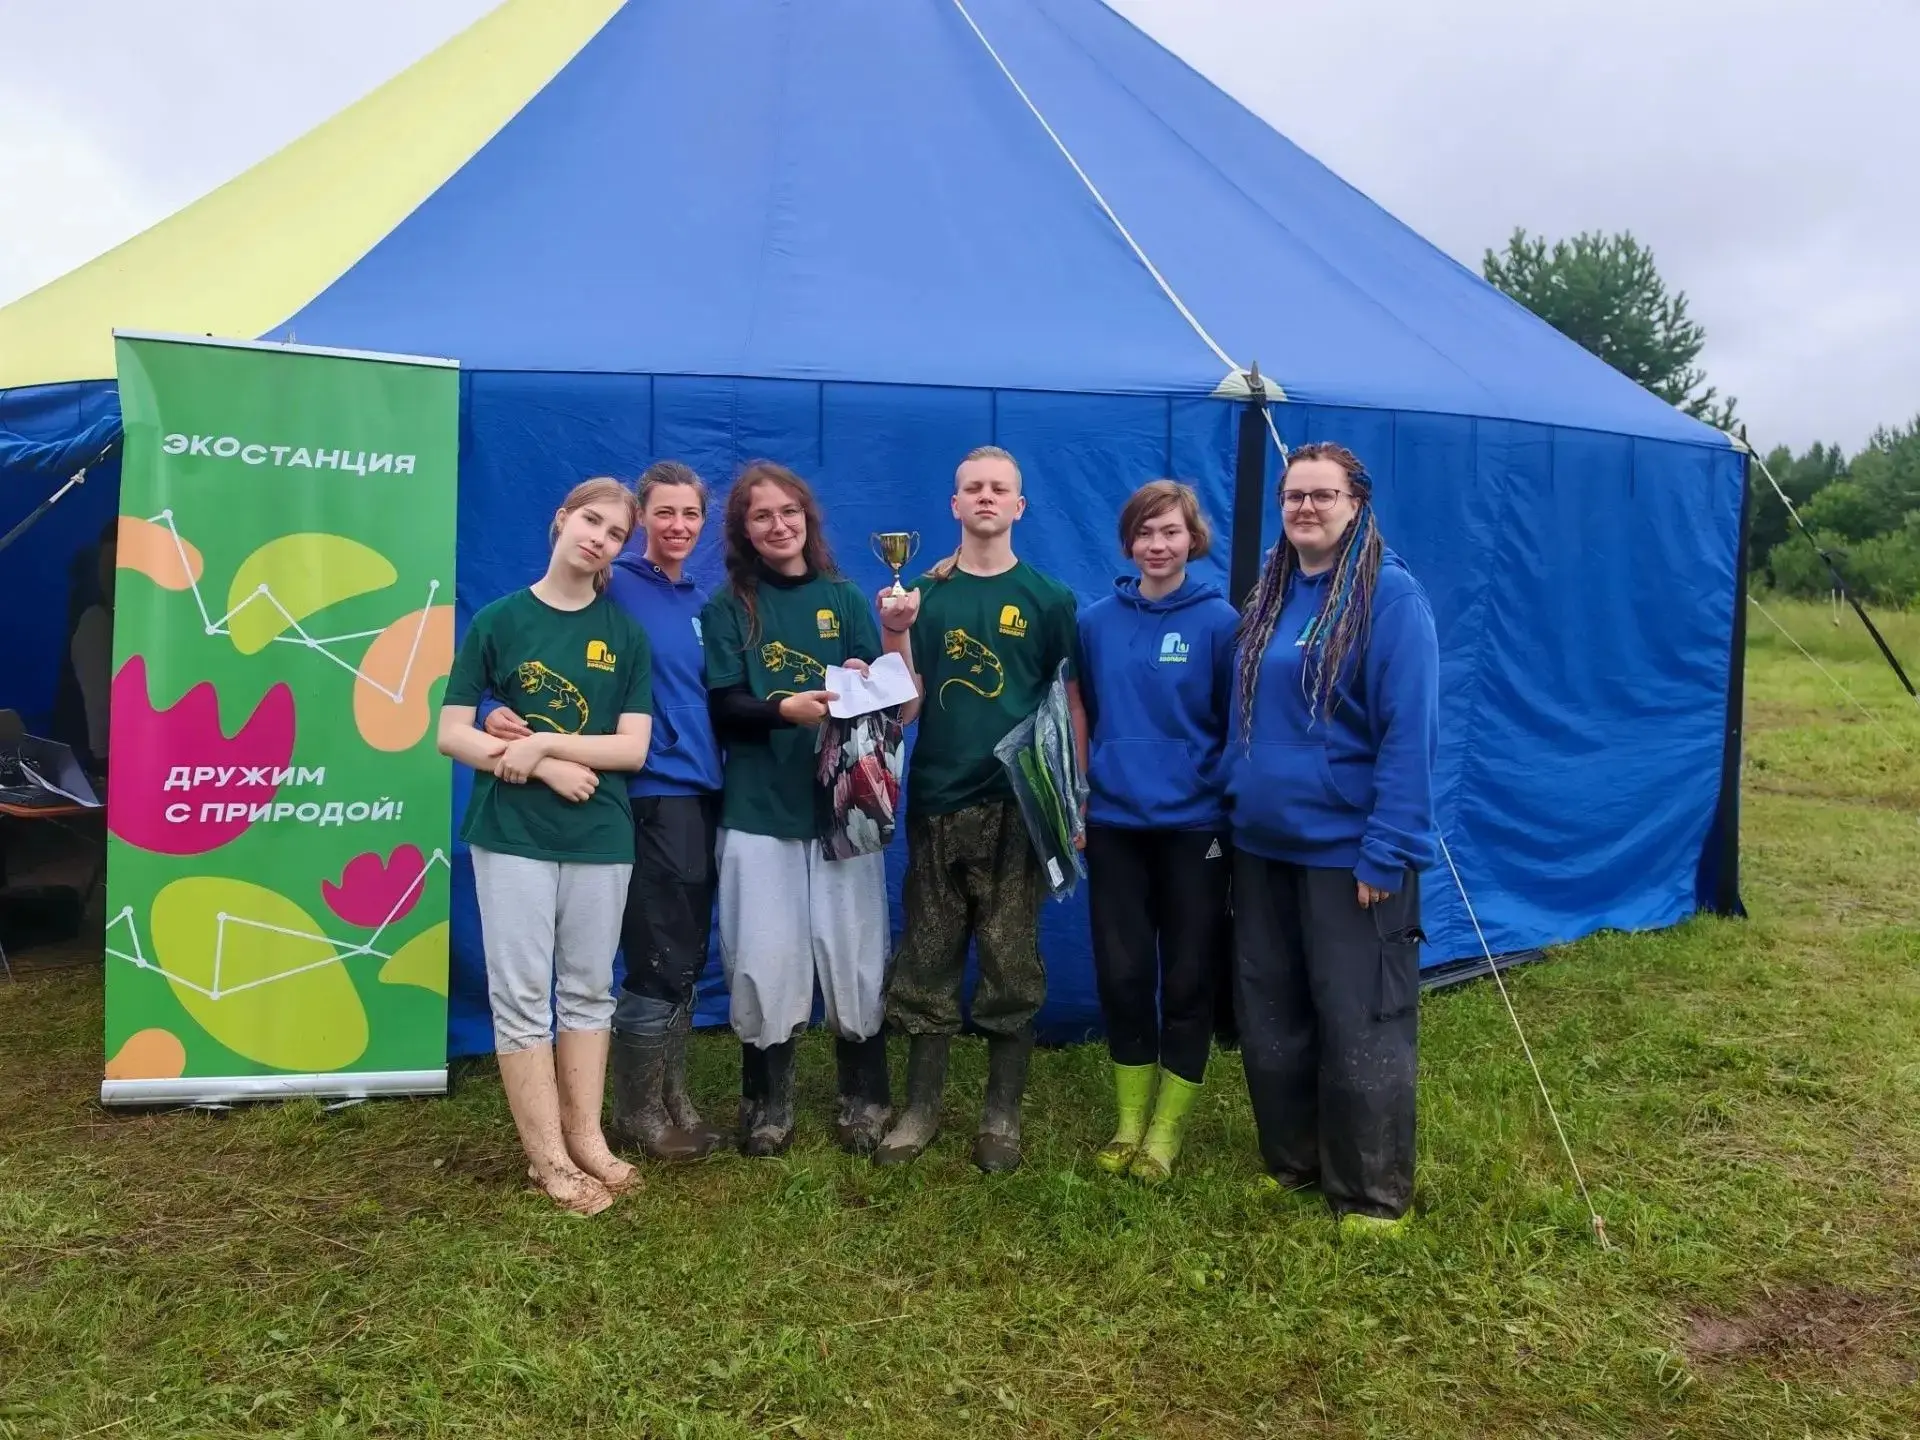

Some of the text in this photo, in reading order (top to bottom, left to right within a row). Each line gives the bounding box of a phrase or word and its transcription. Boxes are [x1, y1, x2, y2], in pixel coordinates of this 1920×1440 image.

[162, 433, 416, 476] ЭКОСТАНЦИЯ
[164, 766, 326, 791] ДРУЖИМ
[165, 797, 404, 827] С ПРИРОДОЙ!
